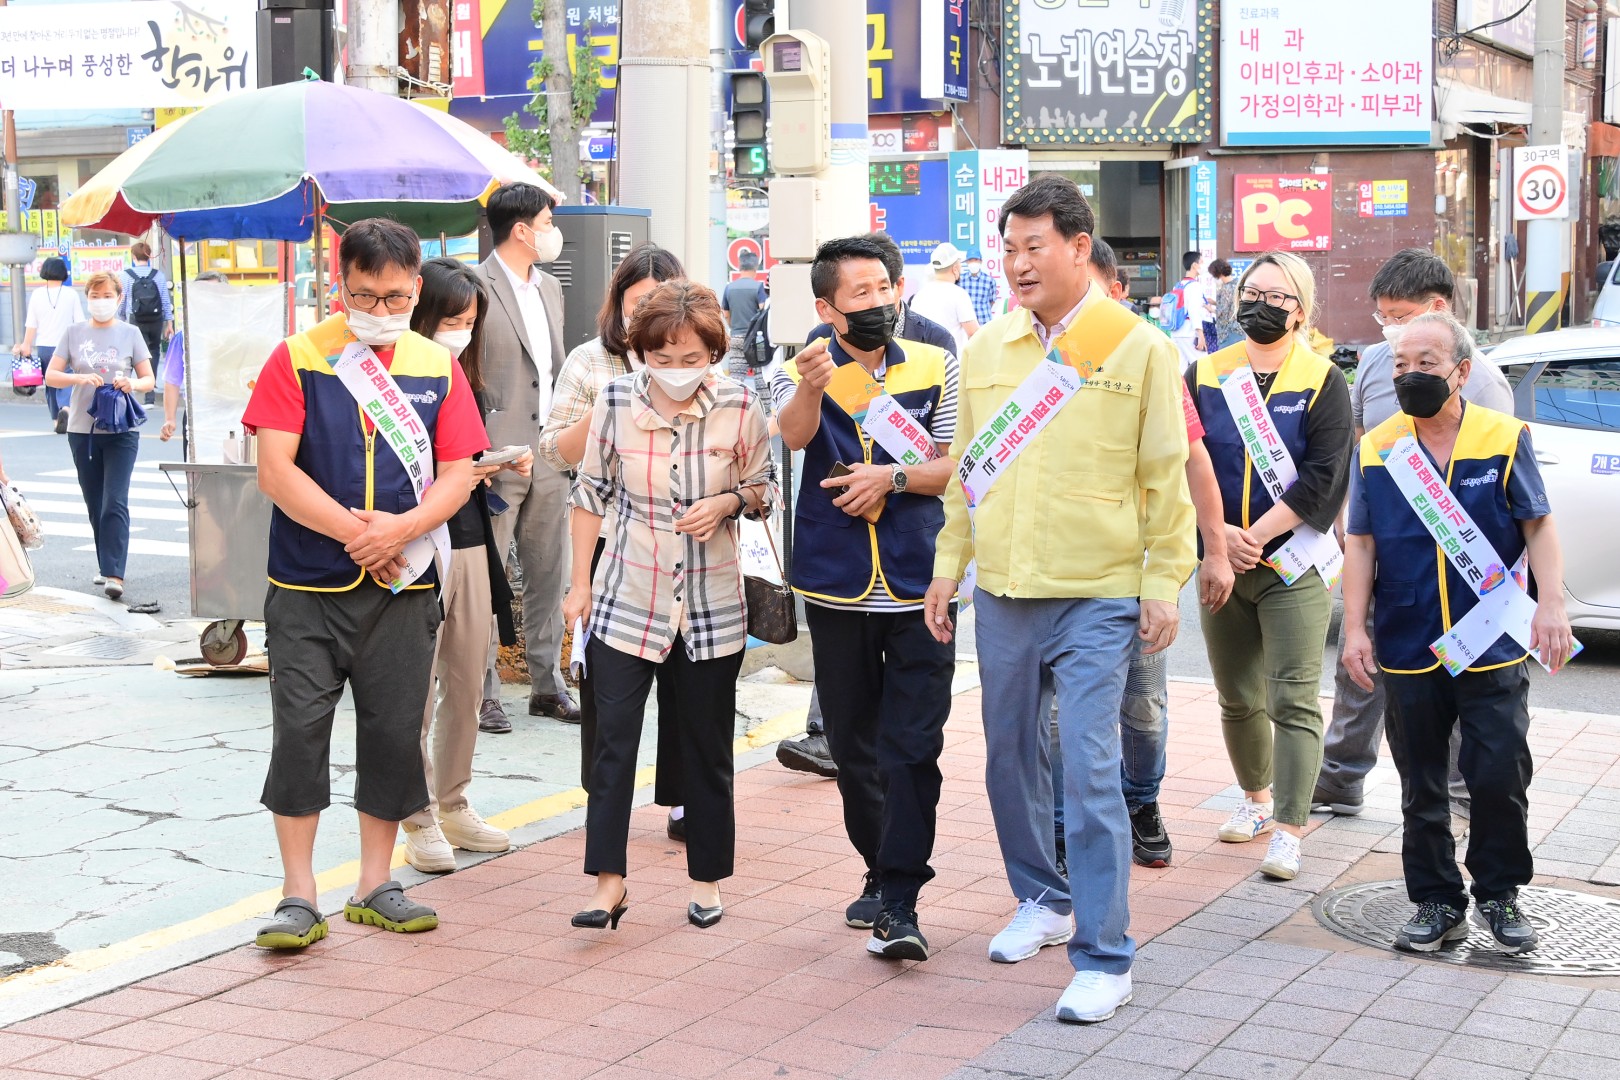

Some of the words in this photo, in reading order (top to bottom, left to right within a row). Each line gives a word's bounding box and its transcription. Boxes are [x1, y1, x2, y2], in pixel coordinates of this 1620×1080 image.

[1240, 8, 1279, 20] 진료과목
[1, 56, 16, 78] 더
[24, 55, 73, 78] 나누며
[81, 53, 133, 78] 풍성한
[141, 20, 249, 94] 한가위
[1027, 29, 1194, 96] 노래연습장
[750, 147, 765, 174] 5
[1523, 148, 1561, 162] 30구역
[983, 166, 1026, 192] 내과
[1526, 179, 1556, 201] 30
[1241, 191, 1313, 244] PC
[1315, 235, 1329, 249] 3F
